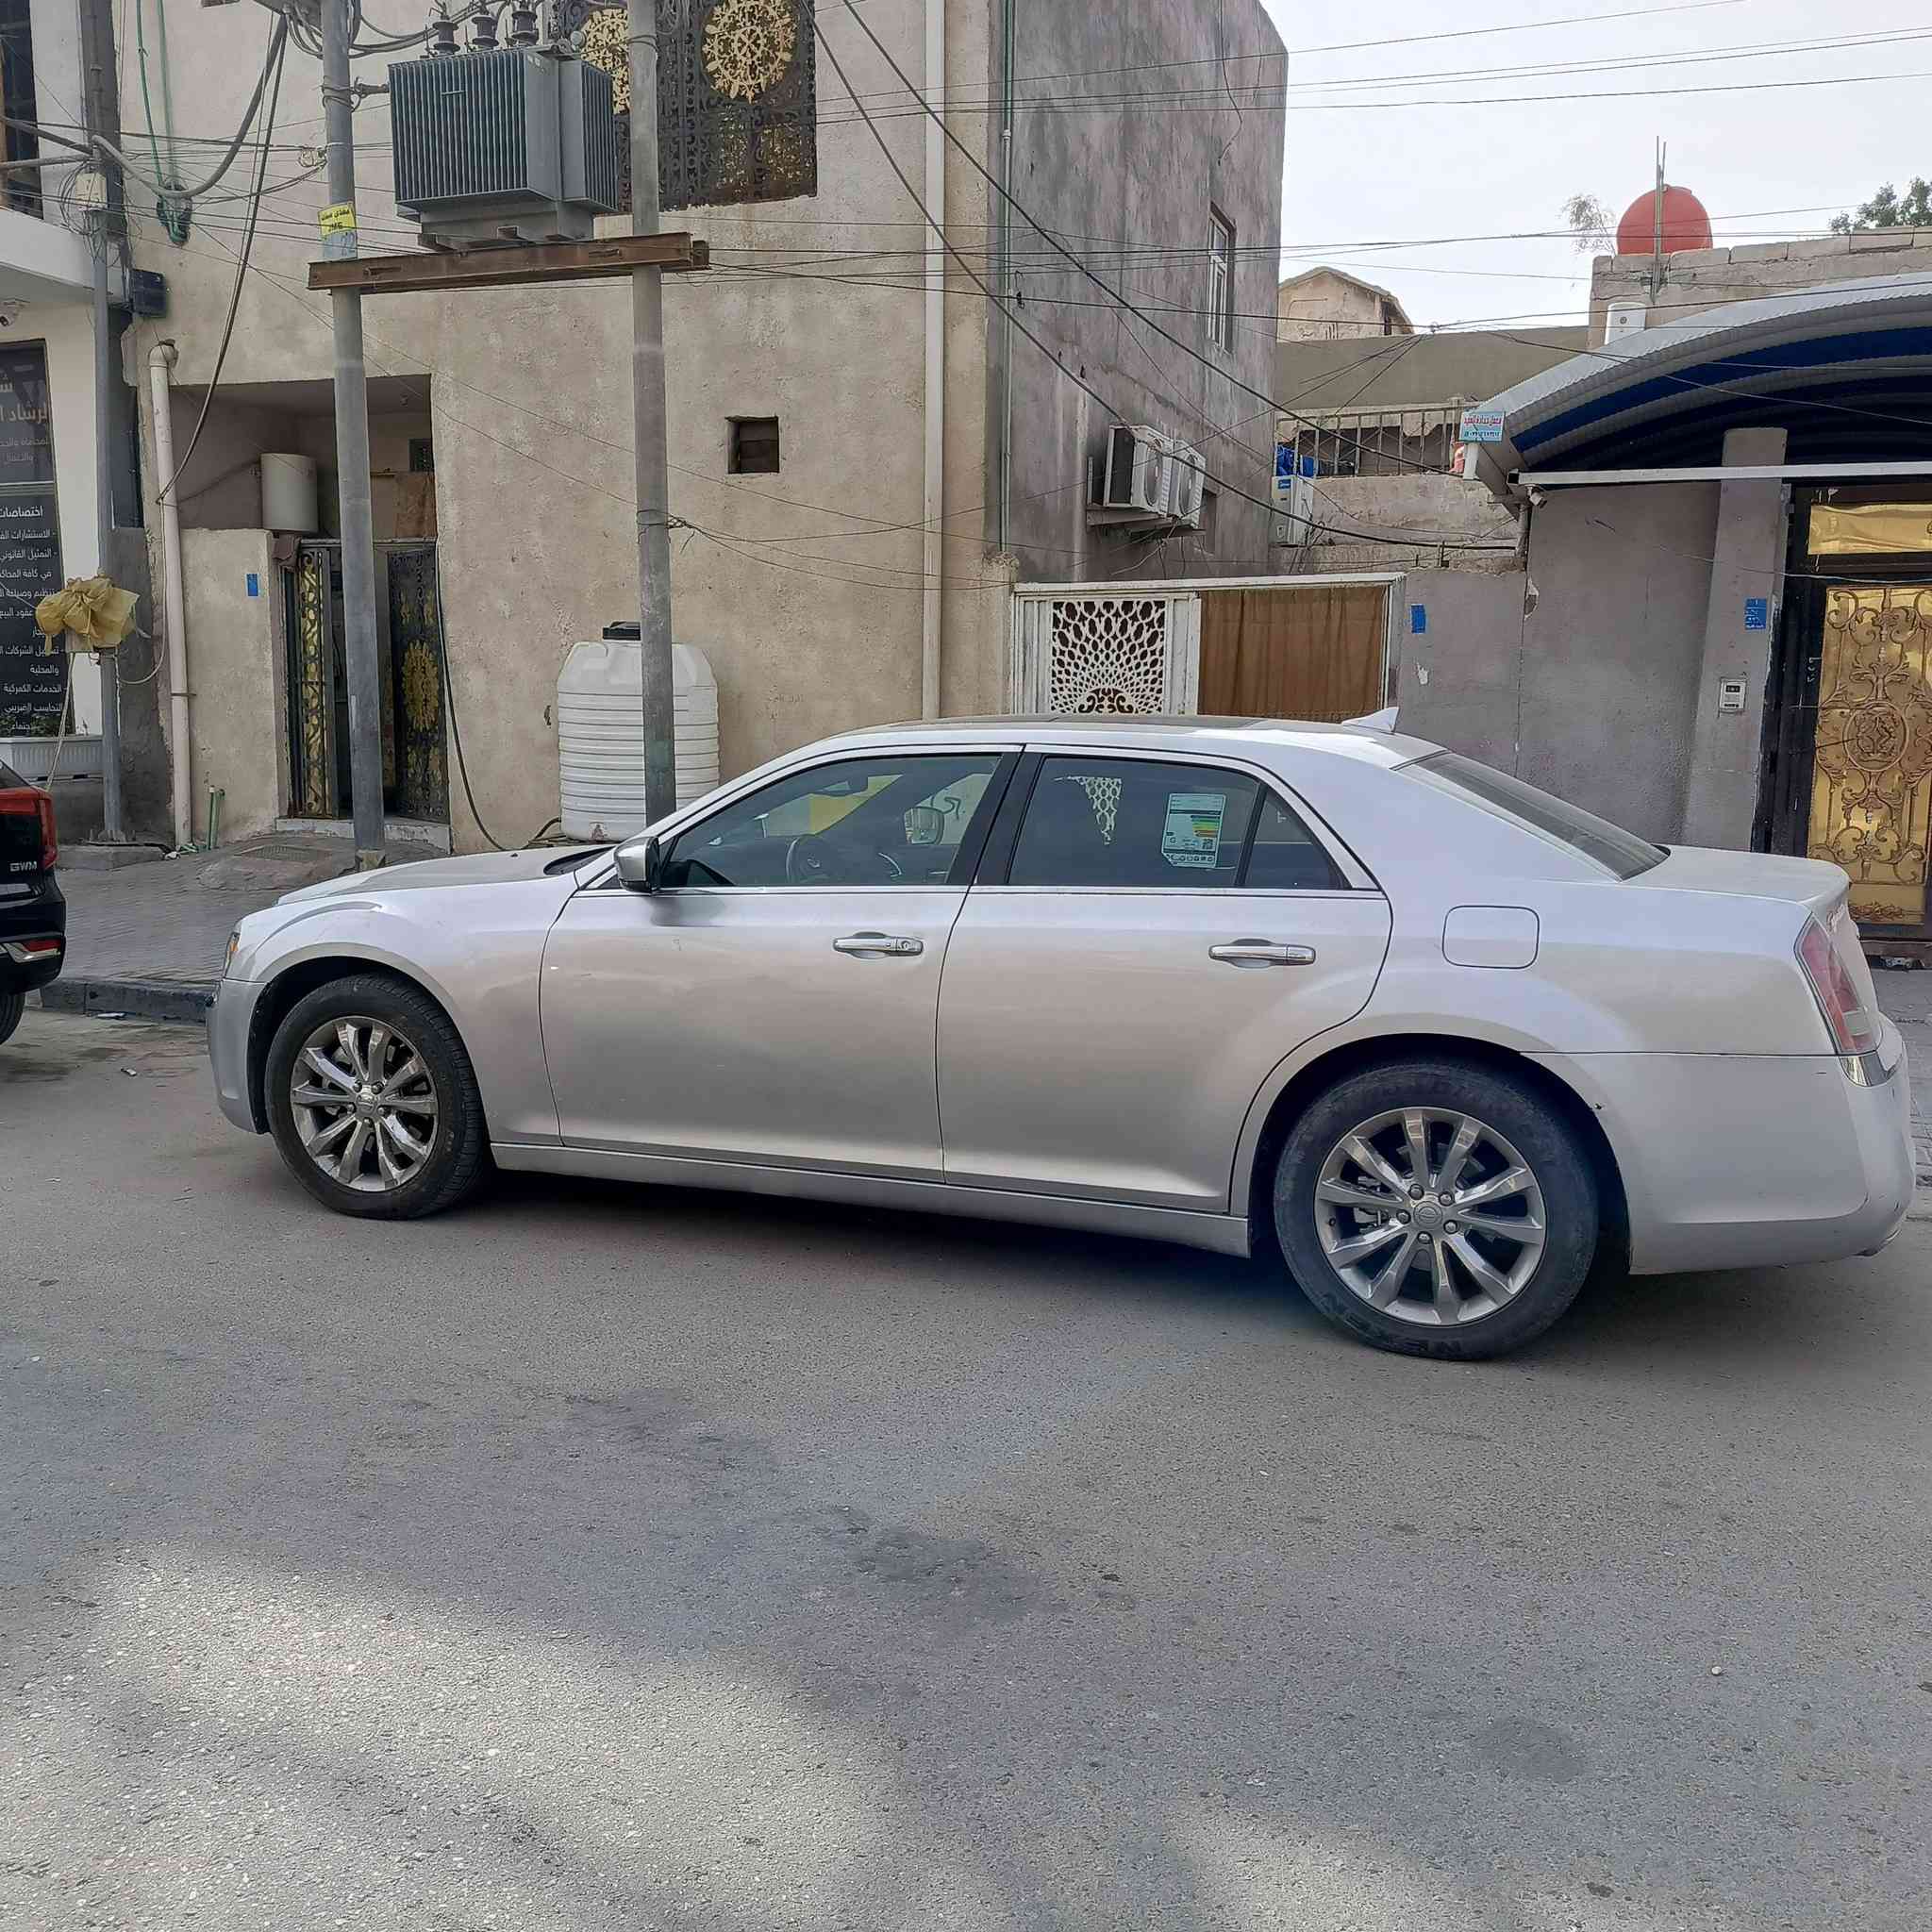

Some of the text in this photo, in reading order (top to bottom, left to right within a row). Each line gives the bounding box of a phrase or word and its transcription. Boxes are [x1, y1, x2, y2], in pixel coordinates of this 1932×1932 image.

[22, 568, 38, 579] كافة
[40, 571, 52, 580] في
[30, 664, 59, 676] والمحلية
[9, 860, 38, 873] GWM
